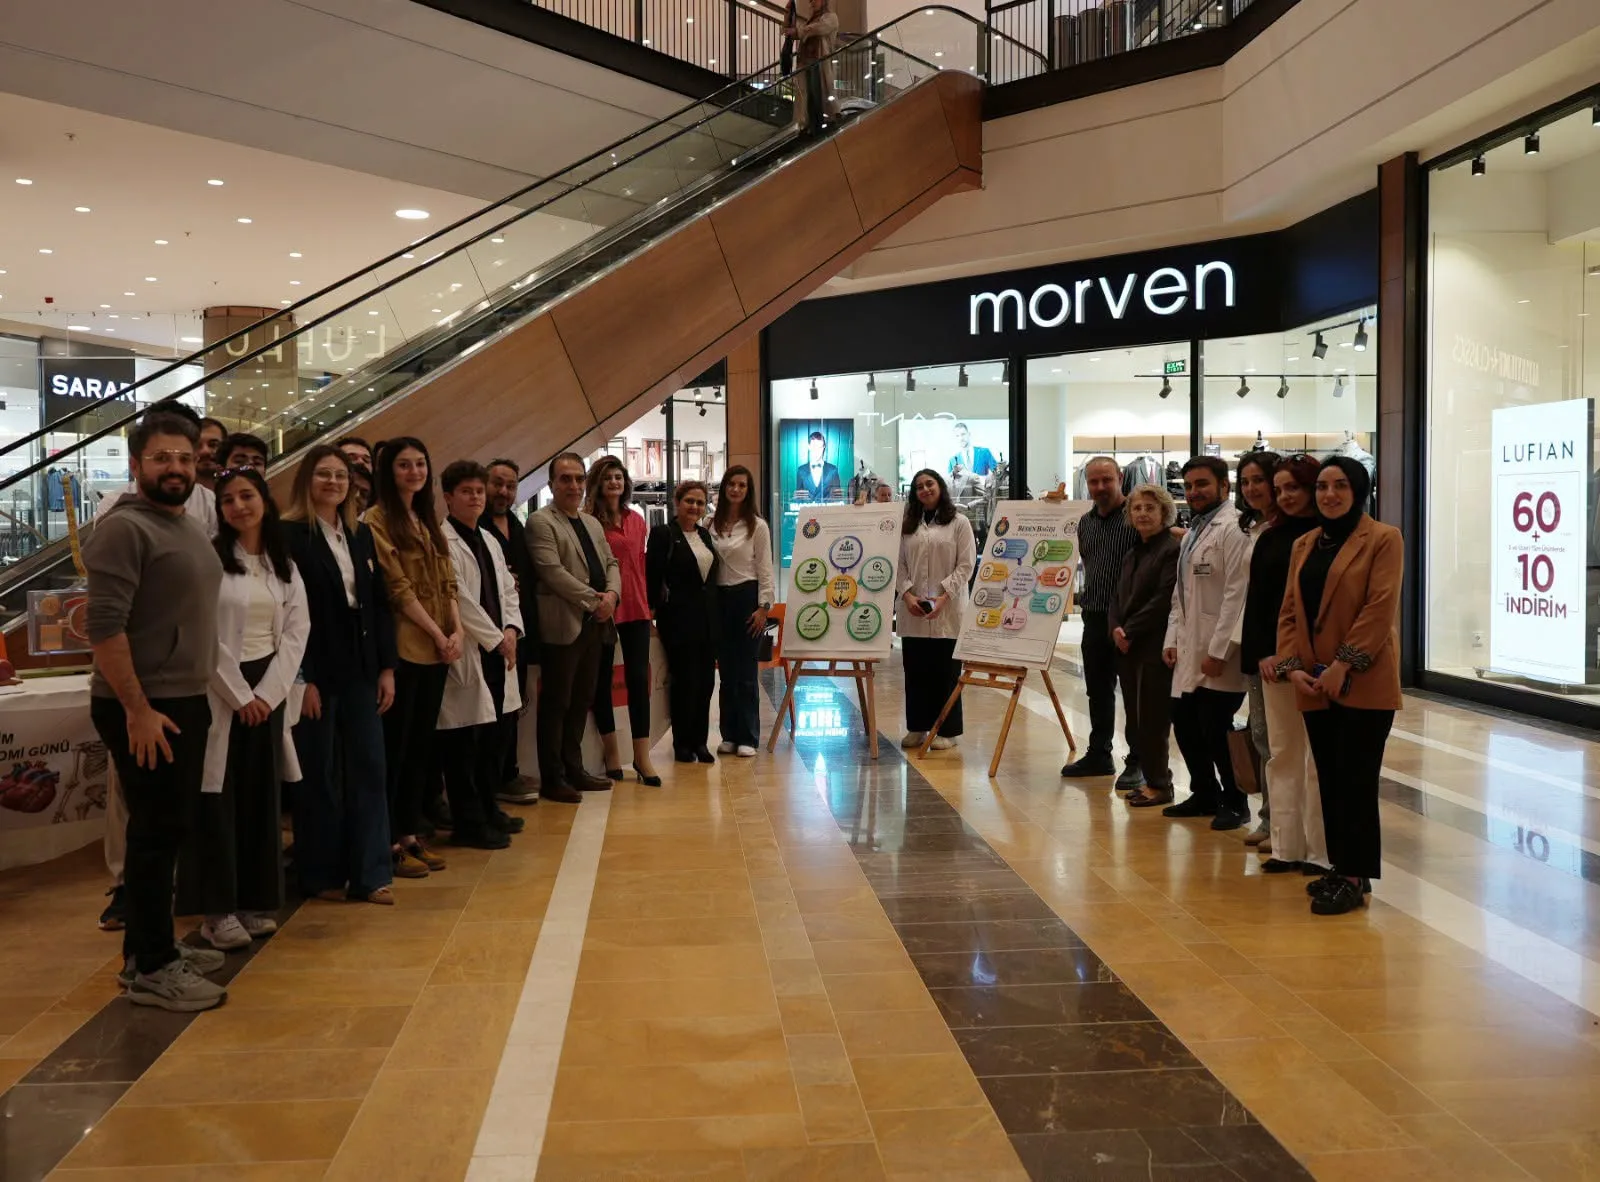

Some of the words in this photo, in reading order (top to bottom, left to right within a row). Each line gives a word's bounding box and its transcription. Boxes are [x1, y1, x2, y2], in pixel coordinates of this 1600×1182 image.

[970, 261, 1235, 335] morven
[1503, 440, 1573, 463] LUFIAN
[1513, 491, 1561, 533] 60
[1517, 553, 1555, 593] 10
[1505, 592, 1568, 619] İNDİRİM
[28, 739, 70, 757] GÜNÜ
